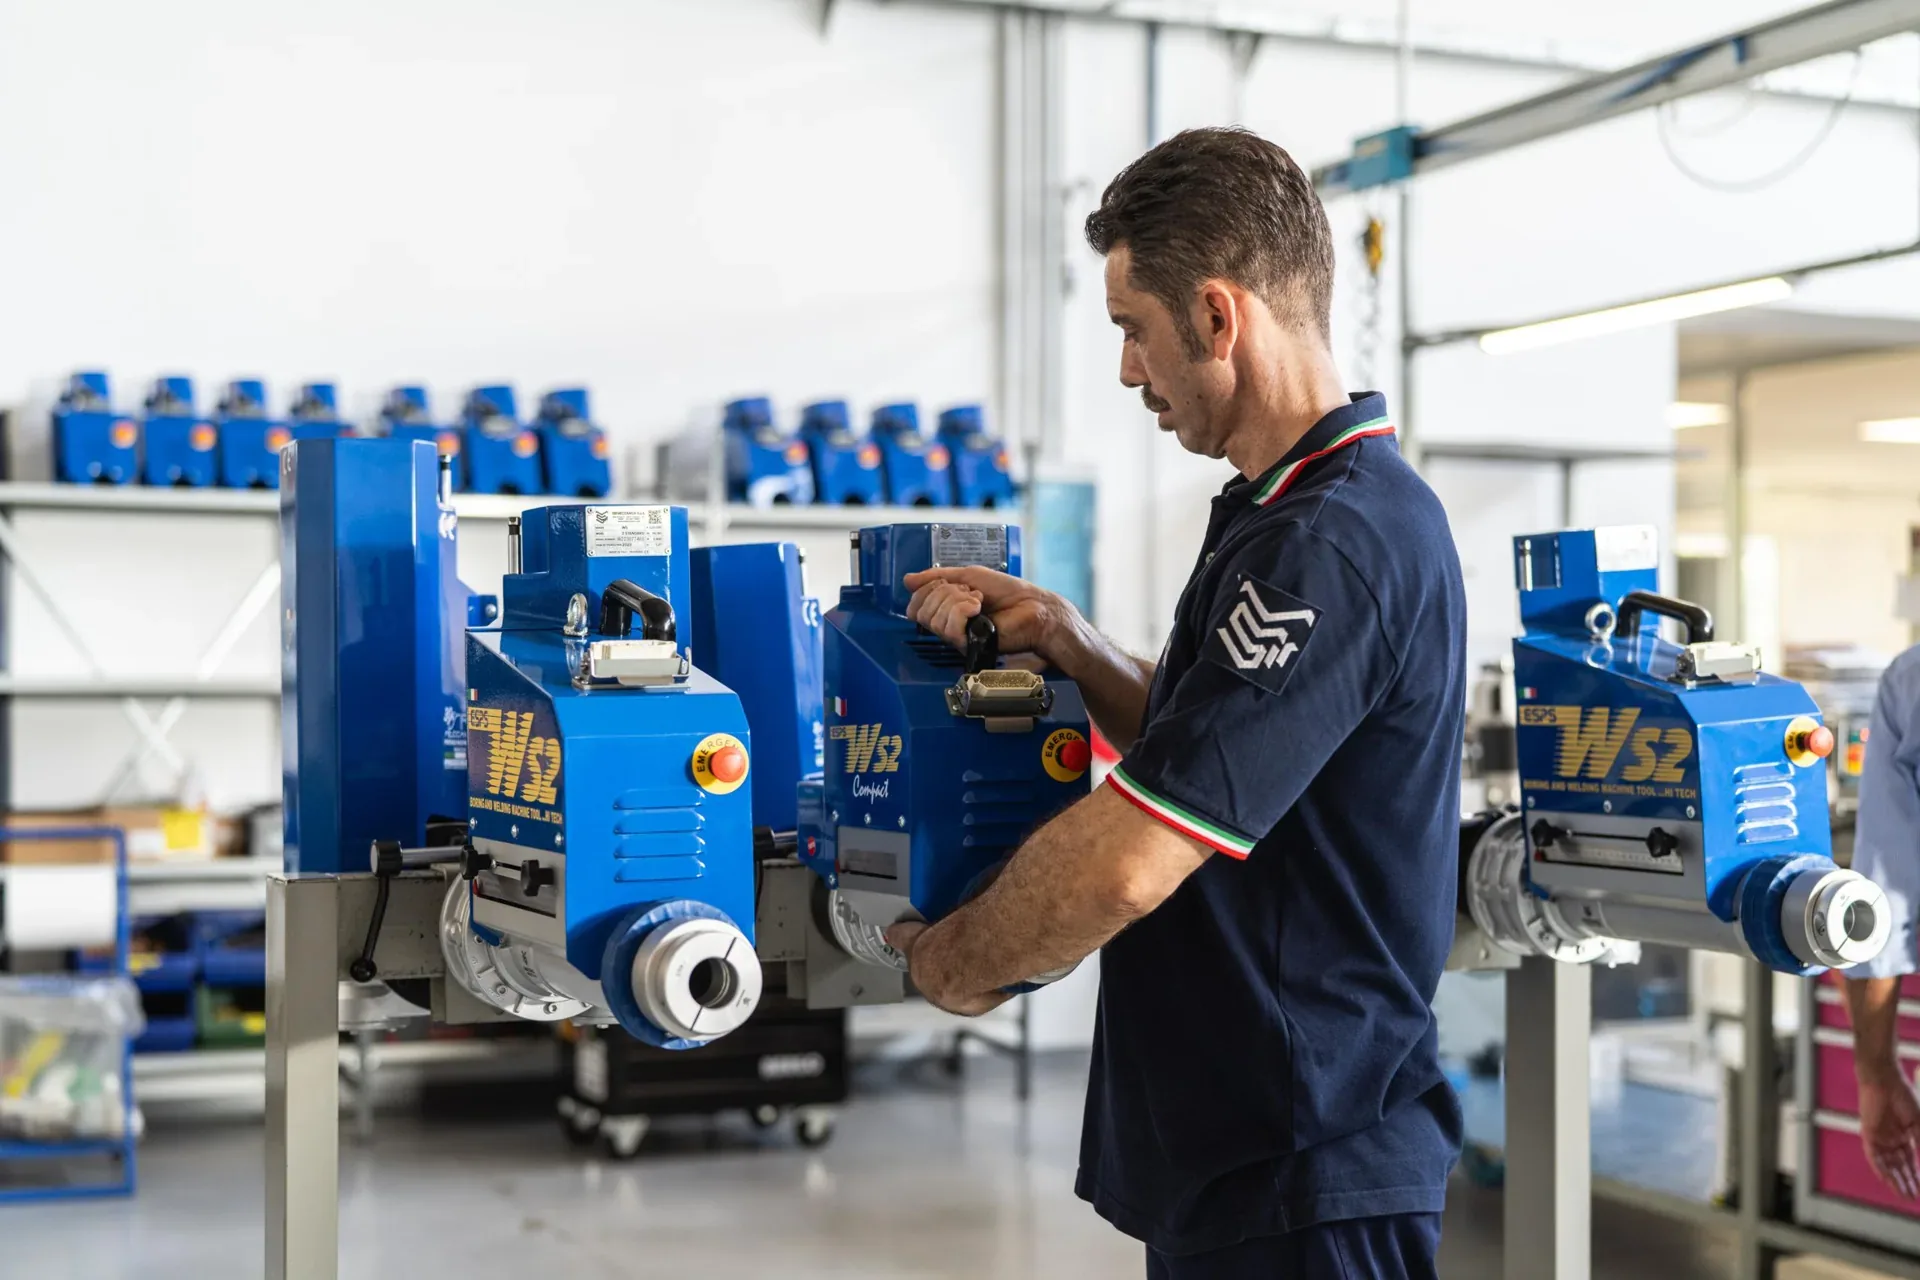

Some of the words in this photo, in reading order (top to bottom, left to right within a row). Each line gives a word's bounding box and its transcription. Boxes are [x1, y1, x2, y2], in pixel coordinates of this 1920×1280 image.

[1524, 708, 1557, 723] ESPS
[852, 774, 889, 805] Compact
[1636, 785, 1656, 796] TOOL
[1675, 788, 1696, 799] TECH
[530, 808, 541, 821] TOOL
[551, 811, 563, 824] TECH
